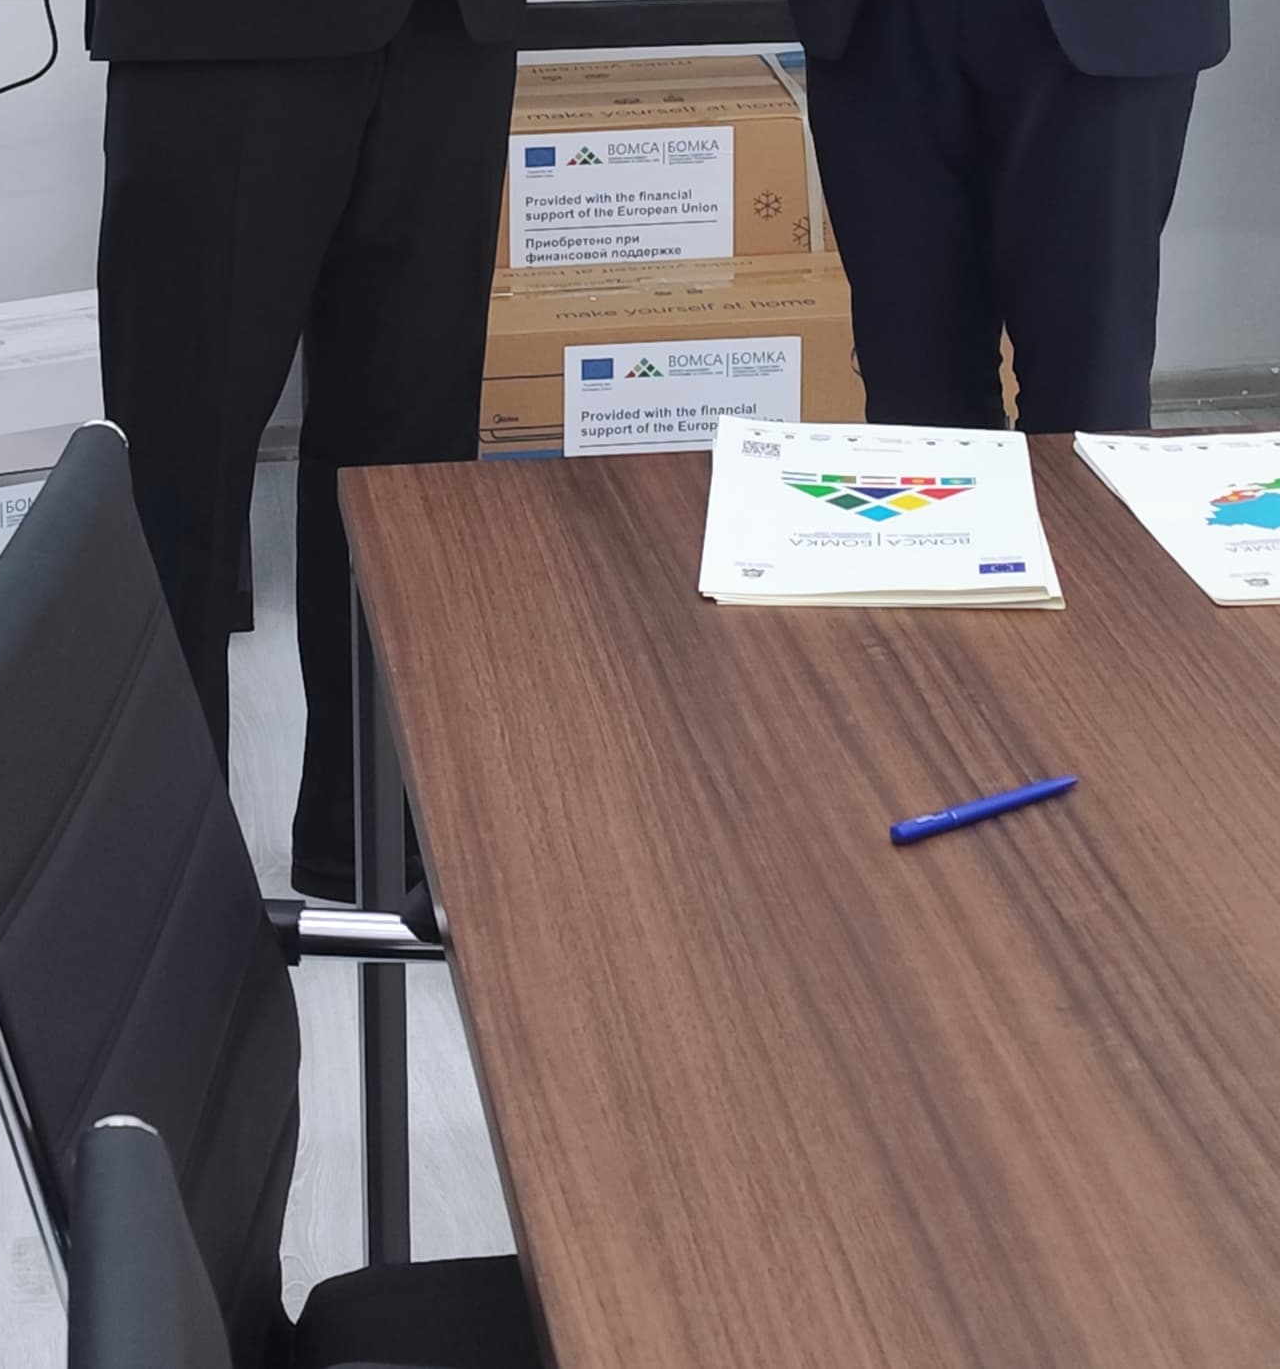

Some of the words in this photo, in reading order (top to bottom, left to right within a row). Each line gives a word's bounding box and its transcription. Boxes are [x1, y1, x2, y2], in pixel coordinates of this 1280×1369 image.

[527, 111, 593, 120] make
[604, 106, 696, 119] yourself
[706, 103, 728, 112] at
[608, 142, 660, 156] BOMCA
[668, 139, 719, 153] БОМКА
[525, 192, 581, 207] Provided
[585, 192, 612, 204] with
[616, 191, 635, 203] the
[638, 189, 692, 202] financial
[525, 209, 574, 222] support
[578, 207, 591, 218] of
[595, 207, 614, 218] the
[618, 205, 677, 218] European
[682, 203, 718, 213] Union
[525, 236, 613, 249] Приобретено
[616, 235, 640, 246] при
[525, 248, 608, 263] финансовой
[612, 247, 682, 259] поддержке
[556, 308, 618, 320] make
[624, 301, 715, 316] yourself
[722, 300, 745, 310] at
[751, 297, 817, 308] home
[669, 354, 723, 368] BOMCA
[731, 351, 786, 365] БОМКА
[581, 409, 640, 422] Provided
[644, 407, 671, 419] with
[677, 406, 696, 417] the
[701, 403, 757, 416] financial
[581, 424, 633, 438] support
[637, 422, 650, 433] of
[654, 421, 673, 432] the
